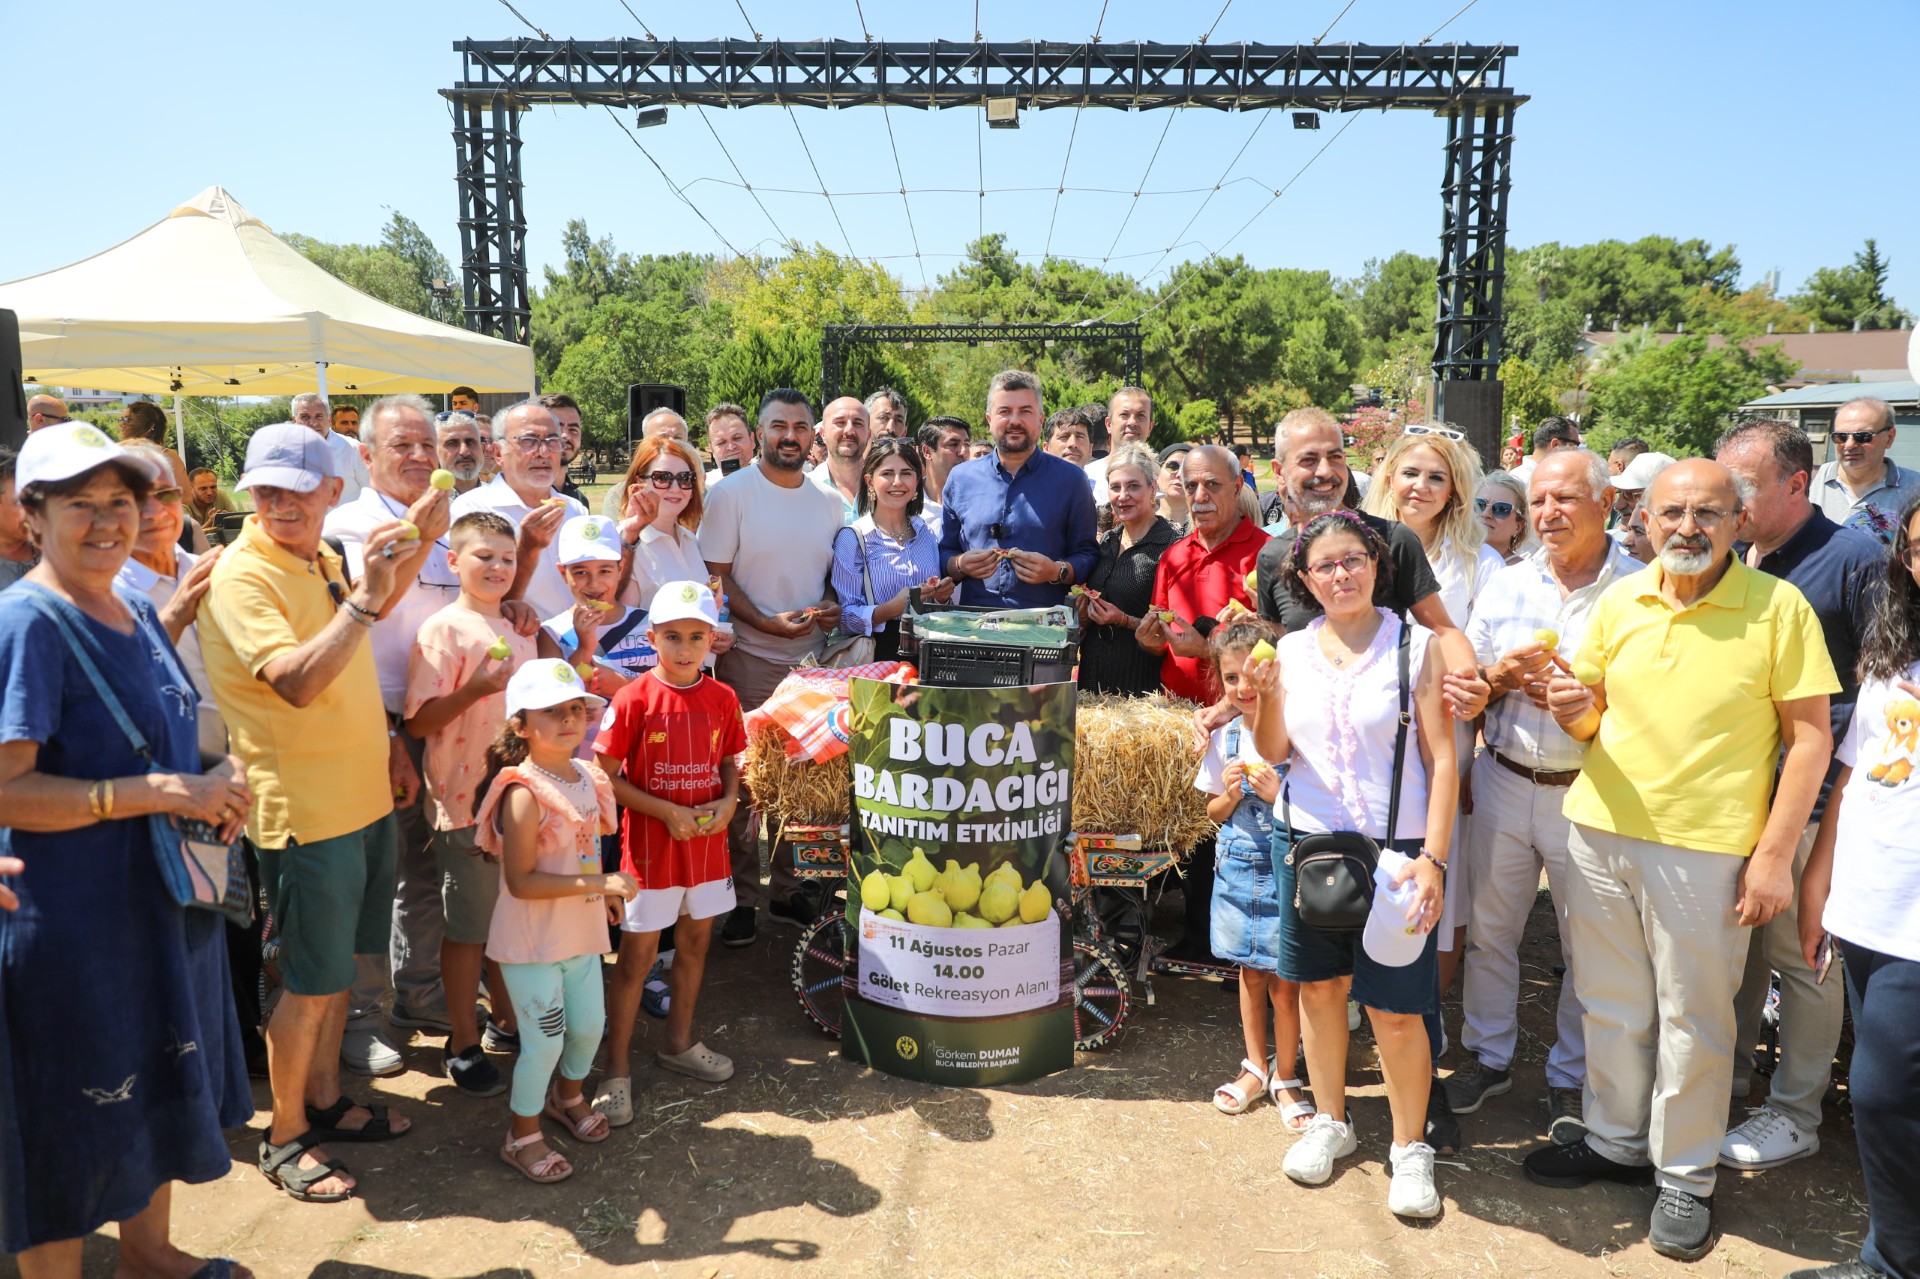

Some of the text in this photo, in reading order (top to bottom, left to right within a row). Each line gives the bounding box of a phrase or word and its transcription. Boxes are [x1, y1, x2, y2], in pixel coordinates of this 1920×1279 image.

[889, 717, 1038, 767] BUCA
[654, 761, 710, 775] Standard
[650, 777, 711, 791] Chartered
[854, 760, 1070, 813] BARDACIĞI
[860, 808, 1062, 844] TANITIM ETKİNLİĞİ
[889, 935, 1030, 958] 11 Ağustos Pazar
[932, 963, 985, 980] 14.00
[868, 971, 1049, 1004] Gölet Rekreasyon Alanı
[935, 1047, 977, 1060] Görkem
[979, 1046, 1020, 1060] DUMAN
[956, 1060, 989, 1068] BELEDİYE
[989, 1057, 1020, 1069] BAŞKANI
